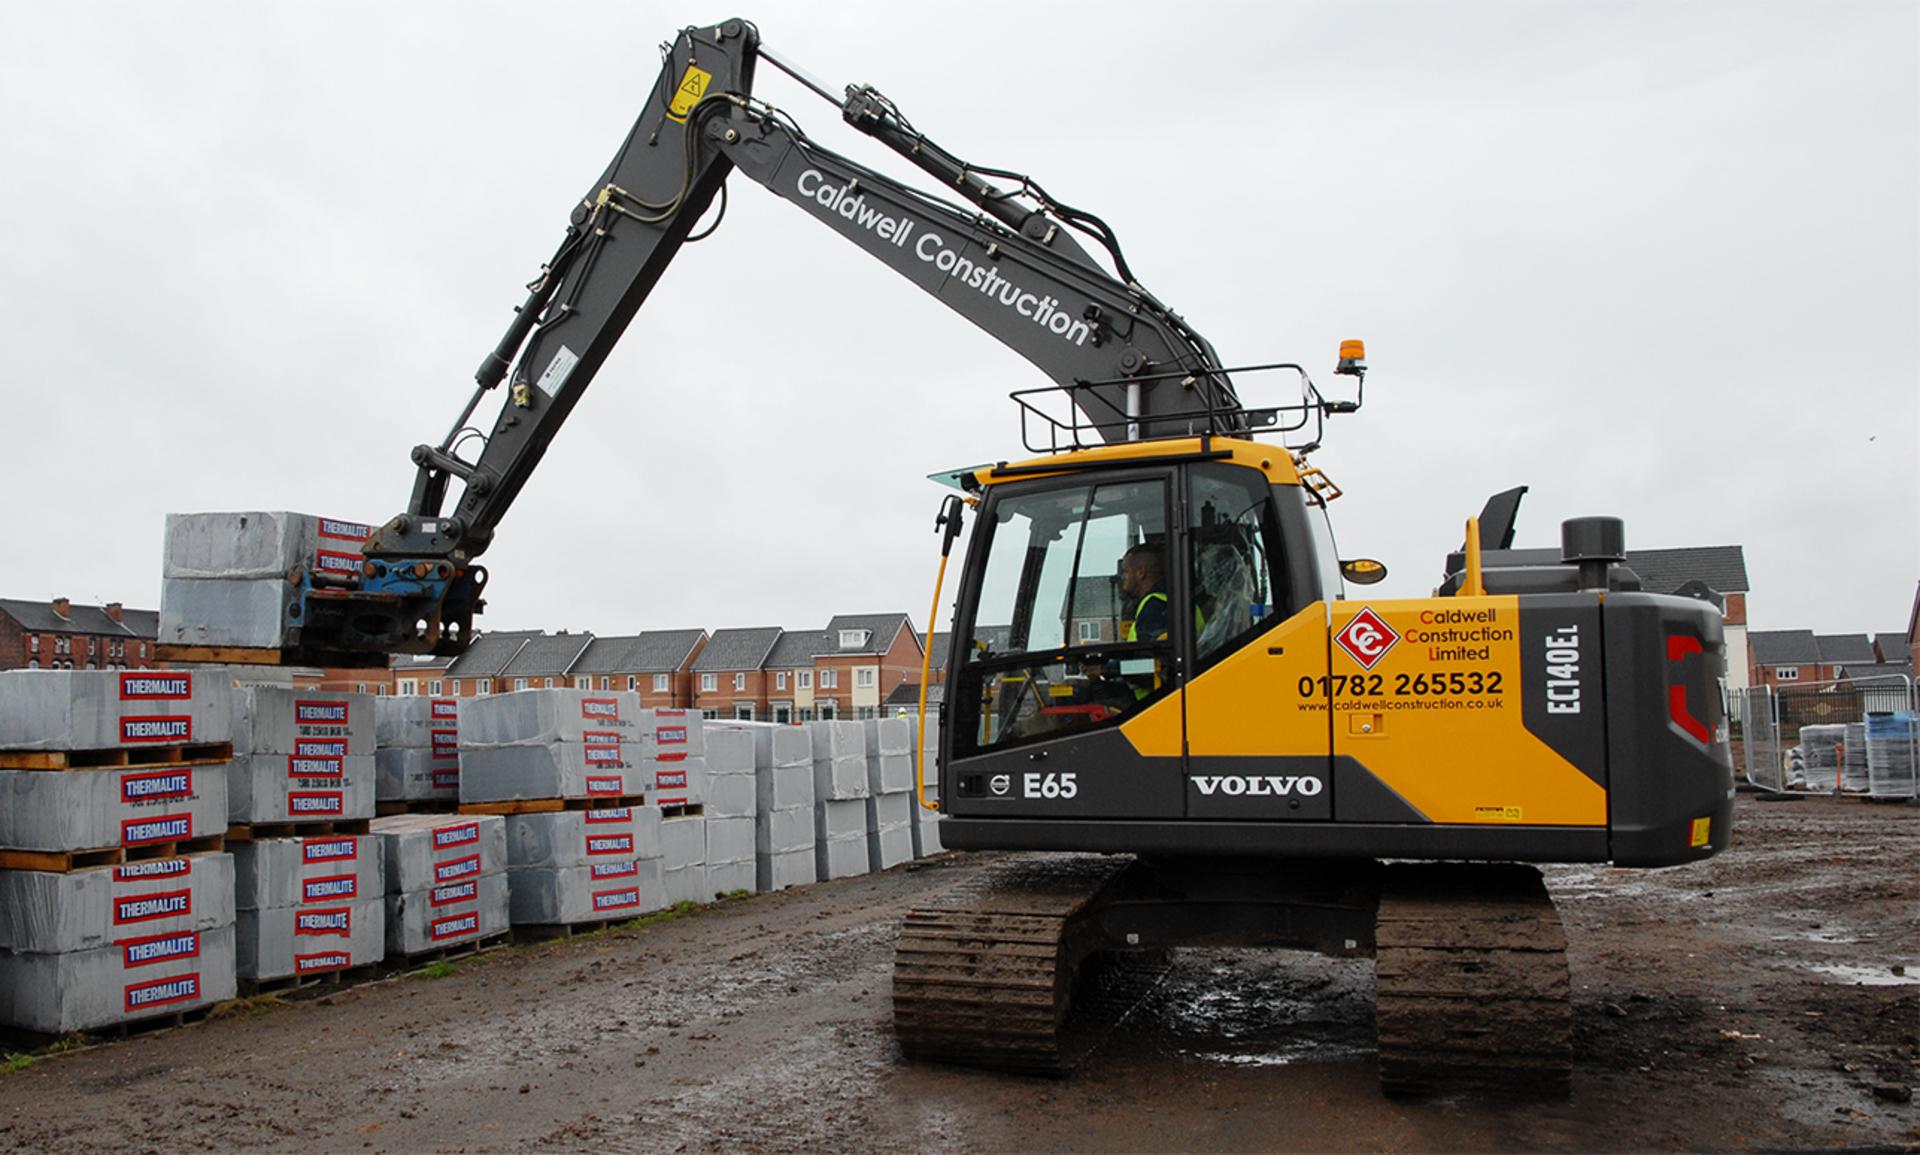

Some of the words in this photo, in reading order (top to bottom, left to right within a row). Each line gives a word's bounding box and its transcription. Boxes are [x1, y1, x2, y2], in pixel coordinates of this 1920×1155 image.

[797, 169, 914, 247] Caldwell
[915, 233, 1090, 346] Construction
[323, 520, 369, 538] THERMALITE
[320, 555, 363, 571] THERMALIT
[1420, 608, 1496, 625] Caldwell
[1405, 627, 1513, 644] Construction
[1429, 646, 1489, 661] Limited
[125, 679, 187, 694] THERMALITE
[1298, 674, 1384, 697] 01782
[1394, 671, 1503, 696] 265532
[299, 706, 345, 719] THERMALITE
[1297, 698, 1504, 711] www.caldwellconstruction.co.uk
[125, 722, 187, 737] THERMALITE
[299, 743, 345, 755] THERMALITE
[292, 759, 340, 773] THERMALITE
[126, 776, 187, 796] THERMALITE
[1024, 772, 1078, 799] E65
[1191, 776, 1322, 796] VOLVO
[292, 797, 340, 810] THERMALITE
[126, 819, 187, 841] THERMALITE
[436, 826, 477, 845] THERMALITE
[306, 841, 354, 858] THERMALITE
[589, 837, 630, 851] THERMALITE
[119, 859, 187, 877] THERMALITE
[438, 859, 478, 878] THERMALITE
[306, 880, 354, 898] THERMALITE
[434, 882, 475, 902] THERMALITE
[120, 896, 187, 919] THERMALITE
[596, 892, 637, 908] THERMALITE
[299, 912, 347, 929] THERMALITE
[435, 917, 476, 936] THERMALITE
[128, 936, 195, 961] THERMALITE
[299, 955, 347, 969] THERMALITE
[130, 979, 195, 1005] THERMALITE
